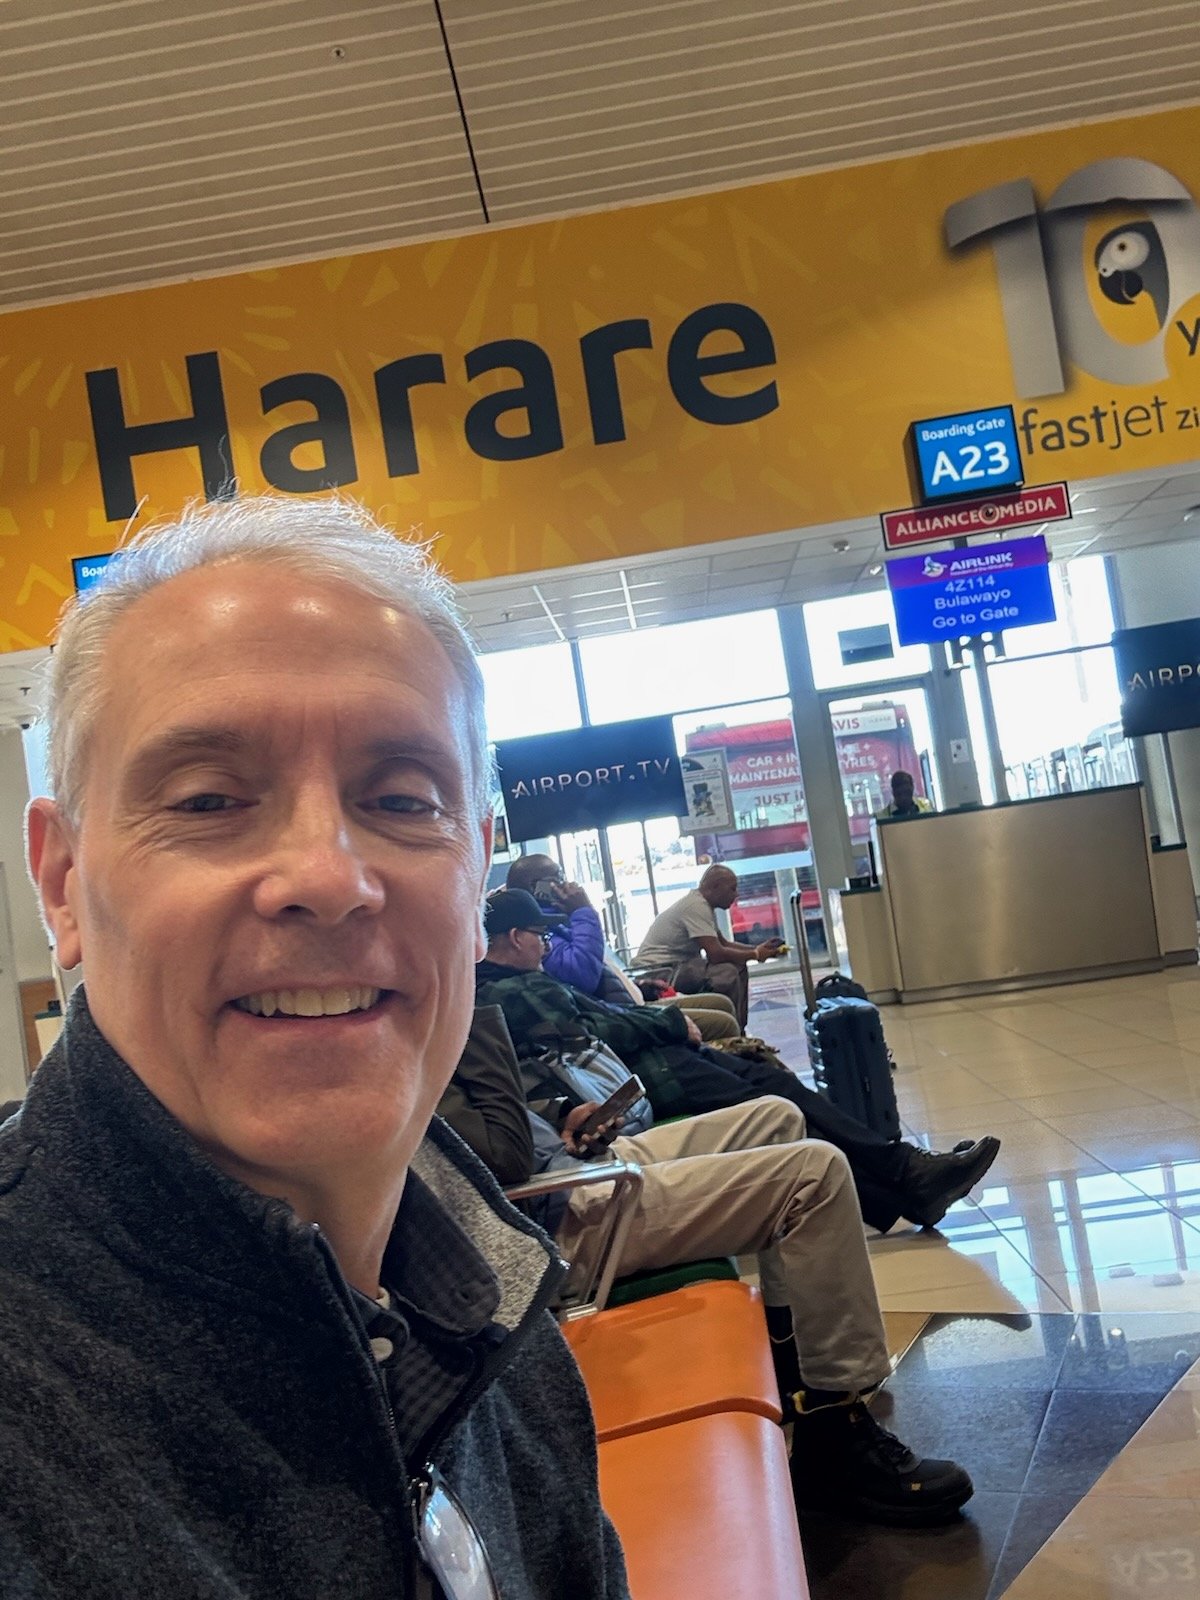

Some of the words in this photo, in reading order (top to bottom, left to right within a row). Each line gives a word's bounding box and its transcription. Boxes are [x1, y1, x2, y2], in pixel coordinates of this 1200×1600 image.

[85, 302, 781, 521] Harare
[922, 422, 975, 441] Boarding
[976, 417, 1006, 432] Gate
[1019, 396, 1168, 455] fastjet
[931, 441, 1010, 486] A23
[896, 511, 980, 536] ALLIANCE
[1000, 497, 1057, 523] MEDIA
[950, 552, 1013, 571] AIRLINK
[934, 588, 1011, 610] Bulawayo
[932, 615, 956, 629] Go
[960, 612, 975, 624] to
[980, 605, 1019, 622] Gate
[747, 755, 772, 768] CAR
[755, 792, 789, 806] JUST
